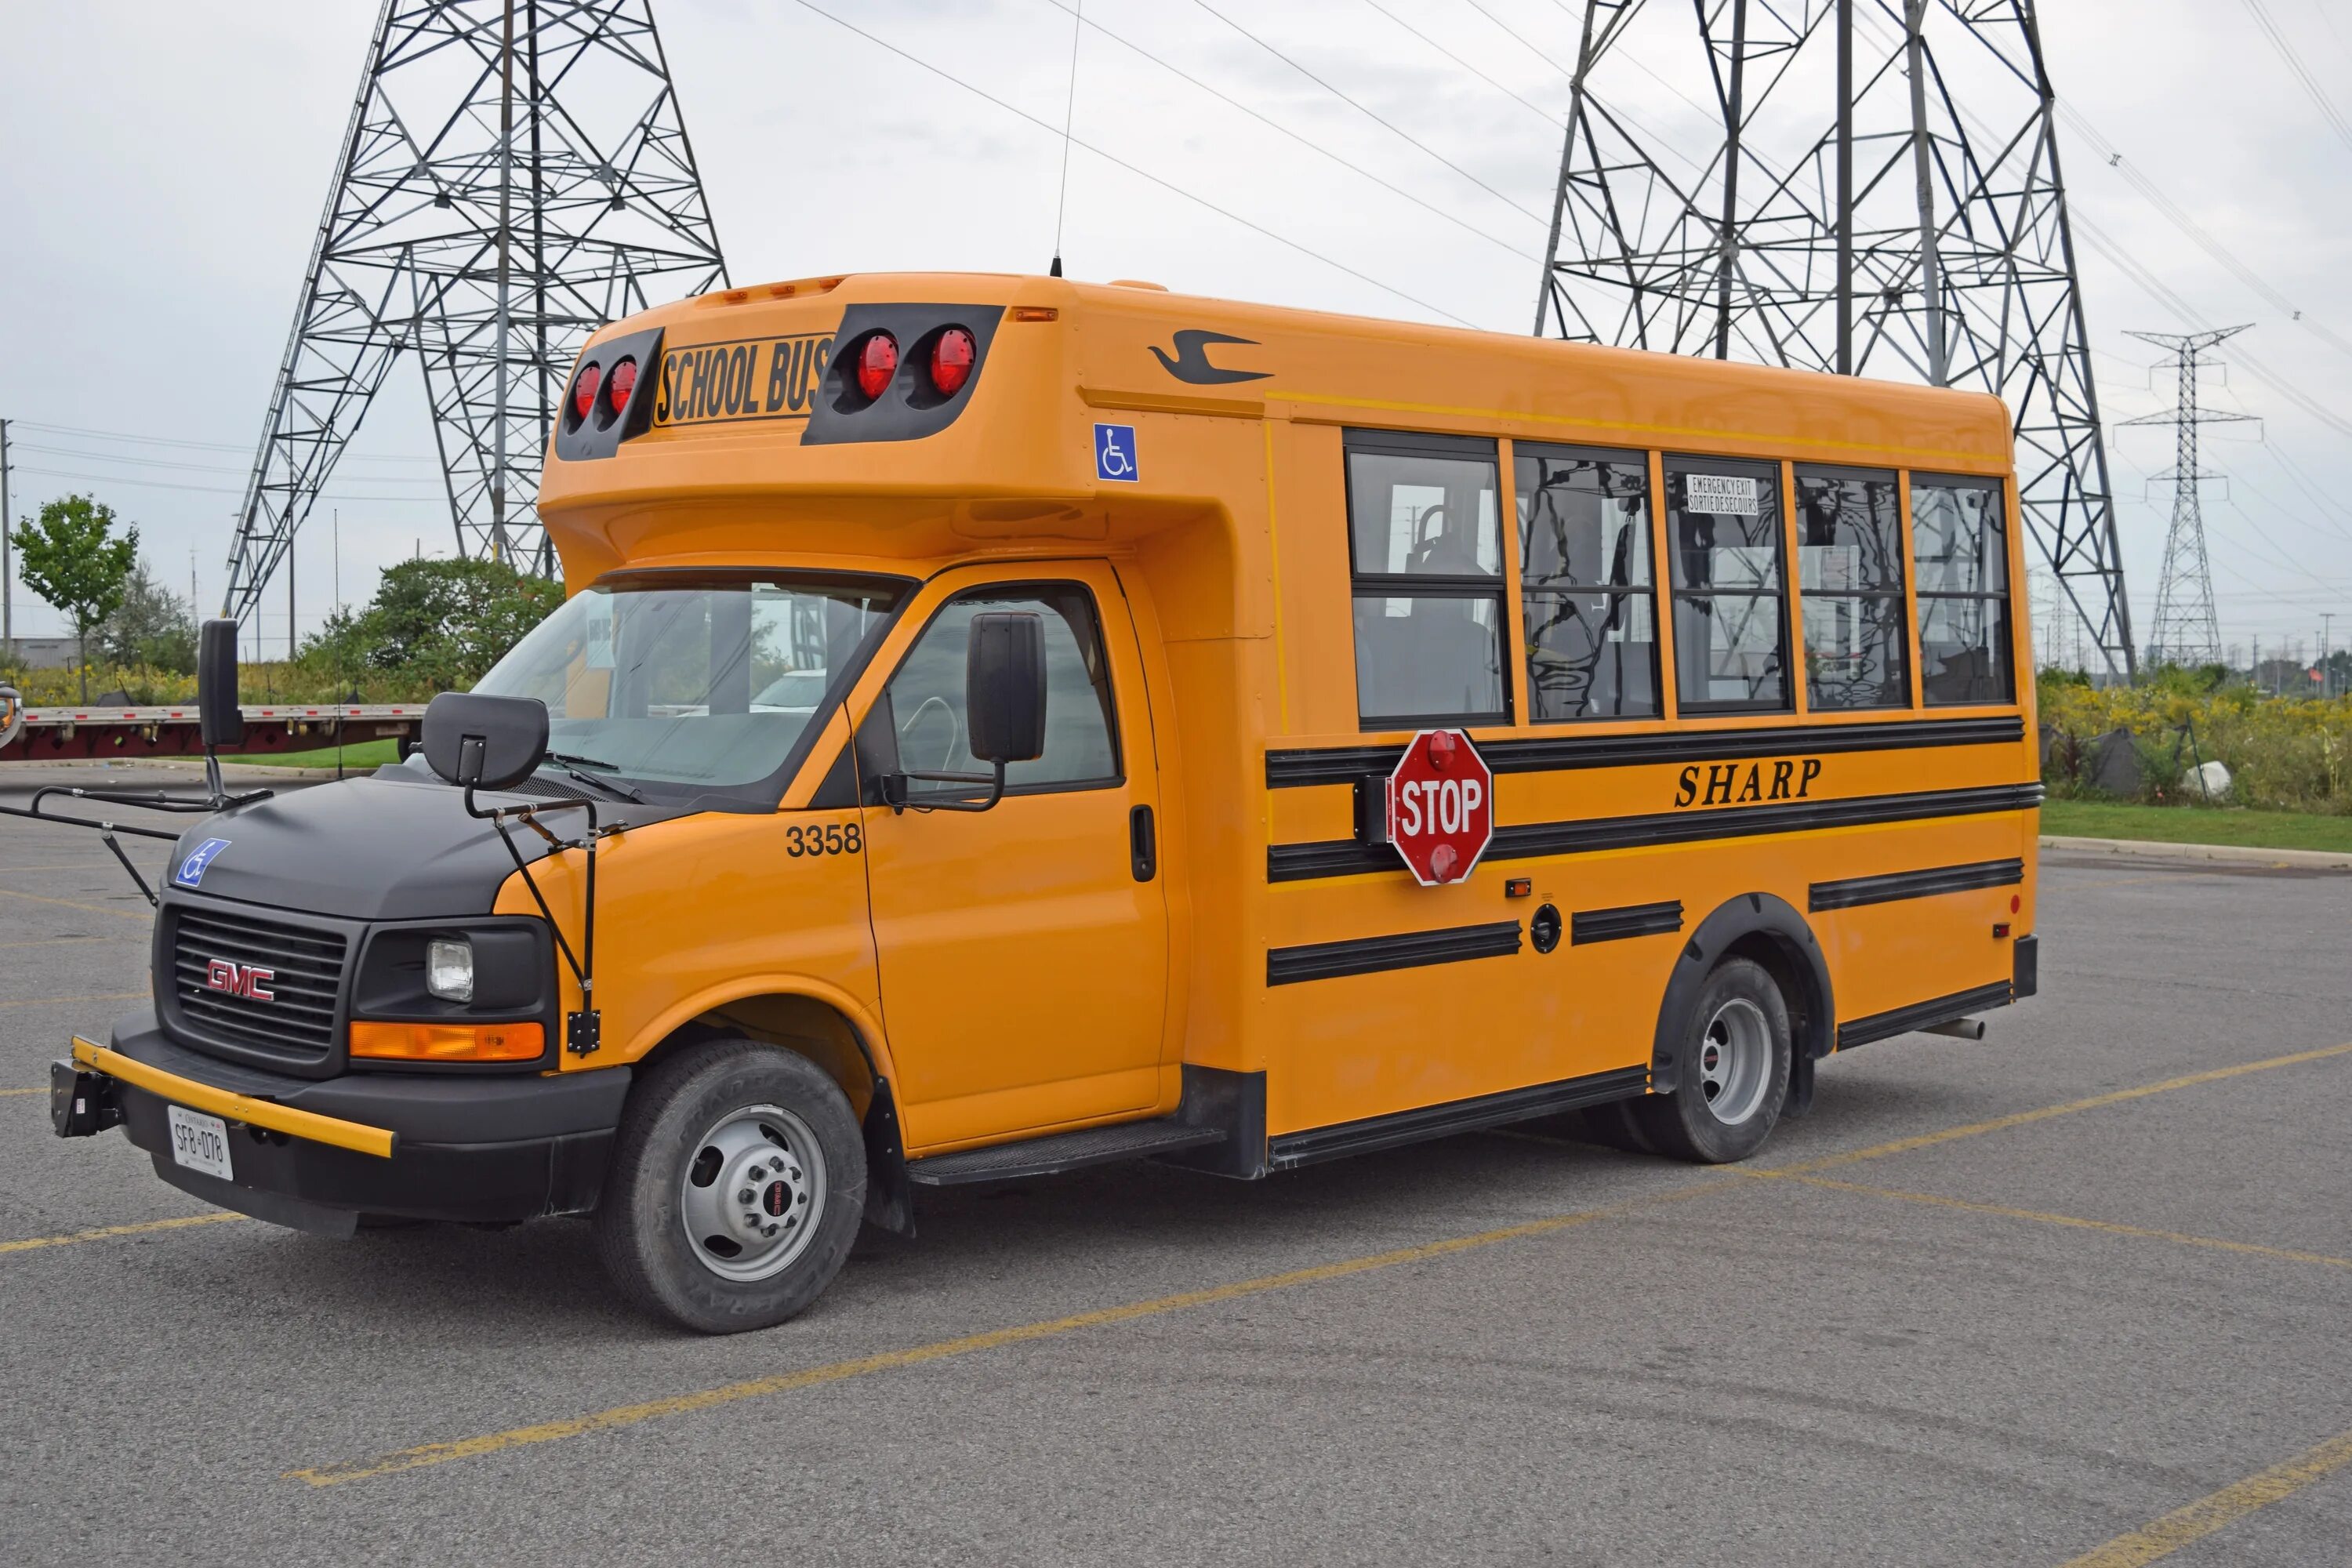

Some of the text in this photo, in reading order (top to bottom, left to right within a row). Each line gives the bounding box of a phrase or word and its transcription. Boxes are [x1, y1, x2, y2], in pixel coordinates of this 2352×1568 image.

[658, 337, 833, 422] SCHOOL BUS
[1689, 495, 1757, 514] SORTIE DE SECOURS
[1693, 477, 1751, 495] EMERGENCY EXIT
[1674, 759, 1821, 808] SHARP
[1402, 779, 1482, 837] STOP
[786, 822, 862, 858] 3358
[208, 958, 274, 1001] GMC
